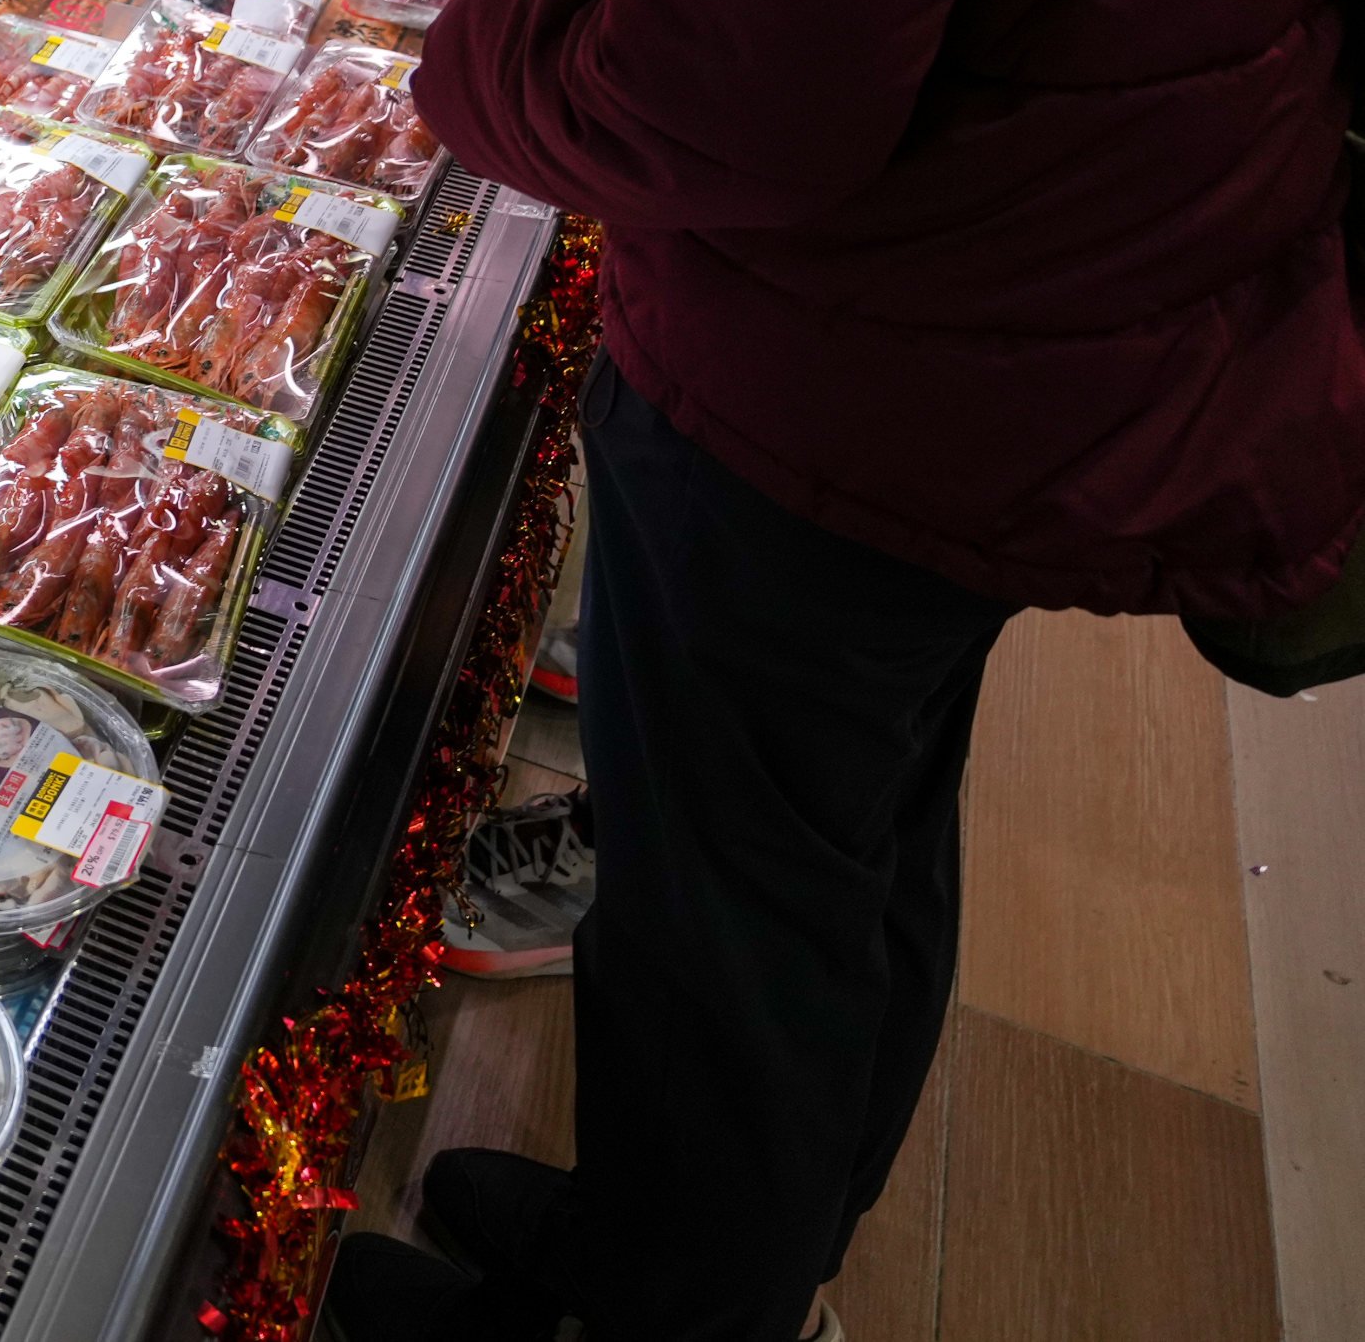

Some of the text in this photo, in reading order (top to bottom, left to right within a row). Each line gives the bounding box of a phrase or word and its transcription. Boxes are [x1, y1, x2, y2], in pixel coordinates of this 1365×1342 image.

[43, 775, 67, 803] DONKI
[134, 786, 153, 808] $99.90
[107, 818, 124, 842] $79.92
[80, 852, 99, 878] 20%
